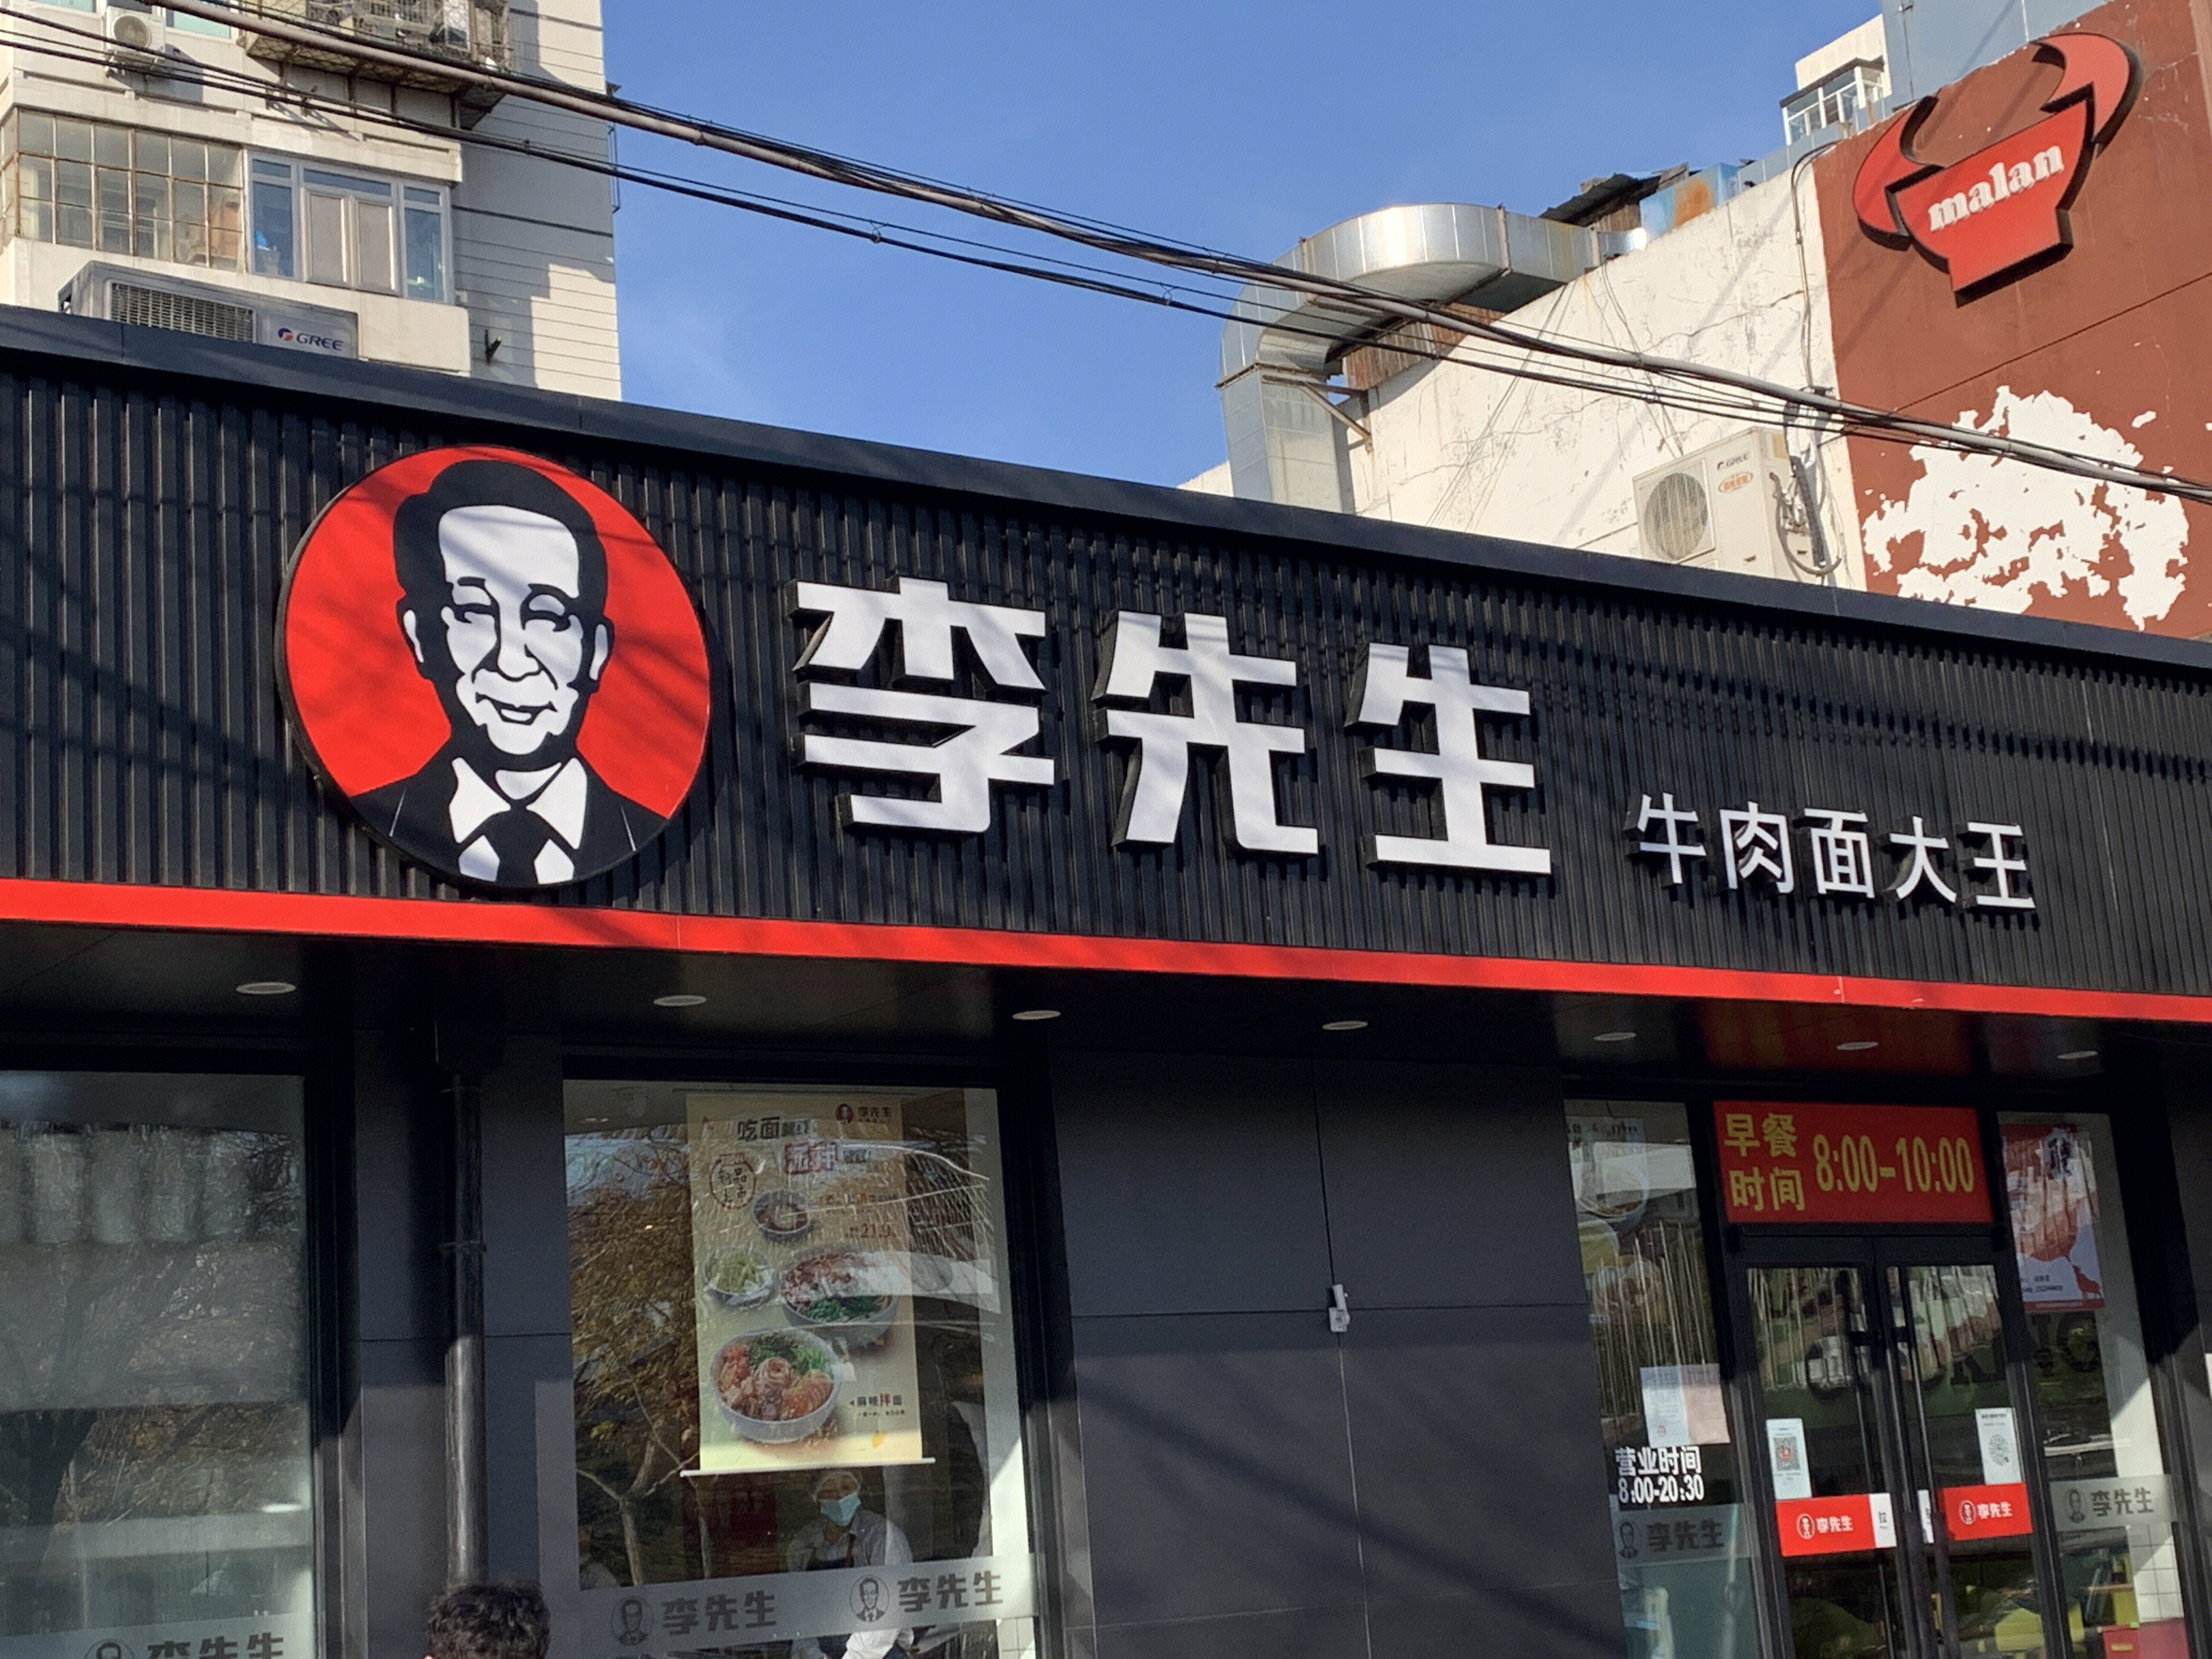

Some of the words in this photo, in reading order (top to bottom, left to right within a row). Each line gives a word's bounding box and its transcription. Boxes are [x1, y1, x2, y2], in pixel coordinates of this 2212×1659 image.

[1928, 143, 2064, 233] malan
[296, 332, 345, 351] GREE
[794, 575, 1551, 874] 李先生
[1638, 792, 2036, 909] 牛肉面大王
[1724, 1111, 1798, 1158] 早餐
[1812, 1133, 1975, 1194] 8:00-10:00
[1729, 1167, 1807, 1213] 时间
[1614, 1445, 1703, 1476] 营业时间
[1616, 1474, 1705, 1504] 8:00-20:30
[1977, 1500, 2013, 1520] 李先生
[2091, 1487, 2155, 1517] 李先生
[1646, 1517, 1726, 1553] 李先生
[1816, 1515, 1854, 1534] 李先生
[662, 1589, 777, 1637] 李先生
[897, 1570, 1004, 1613] 李先生
